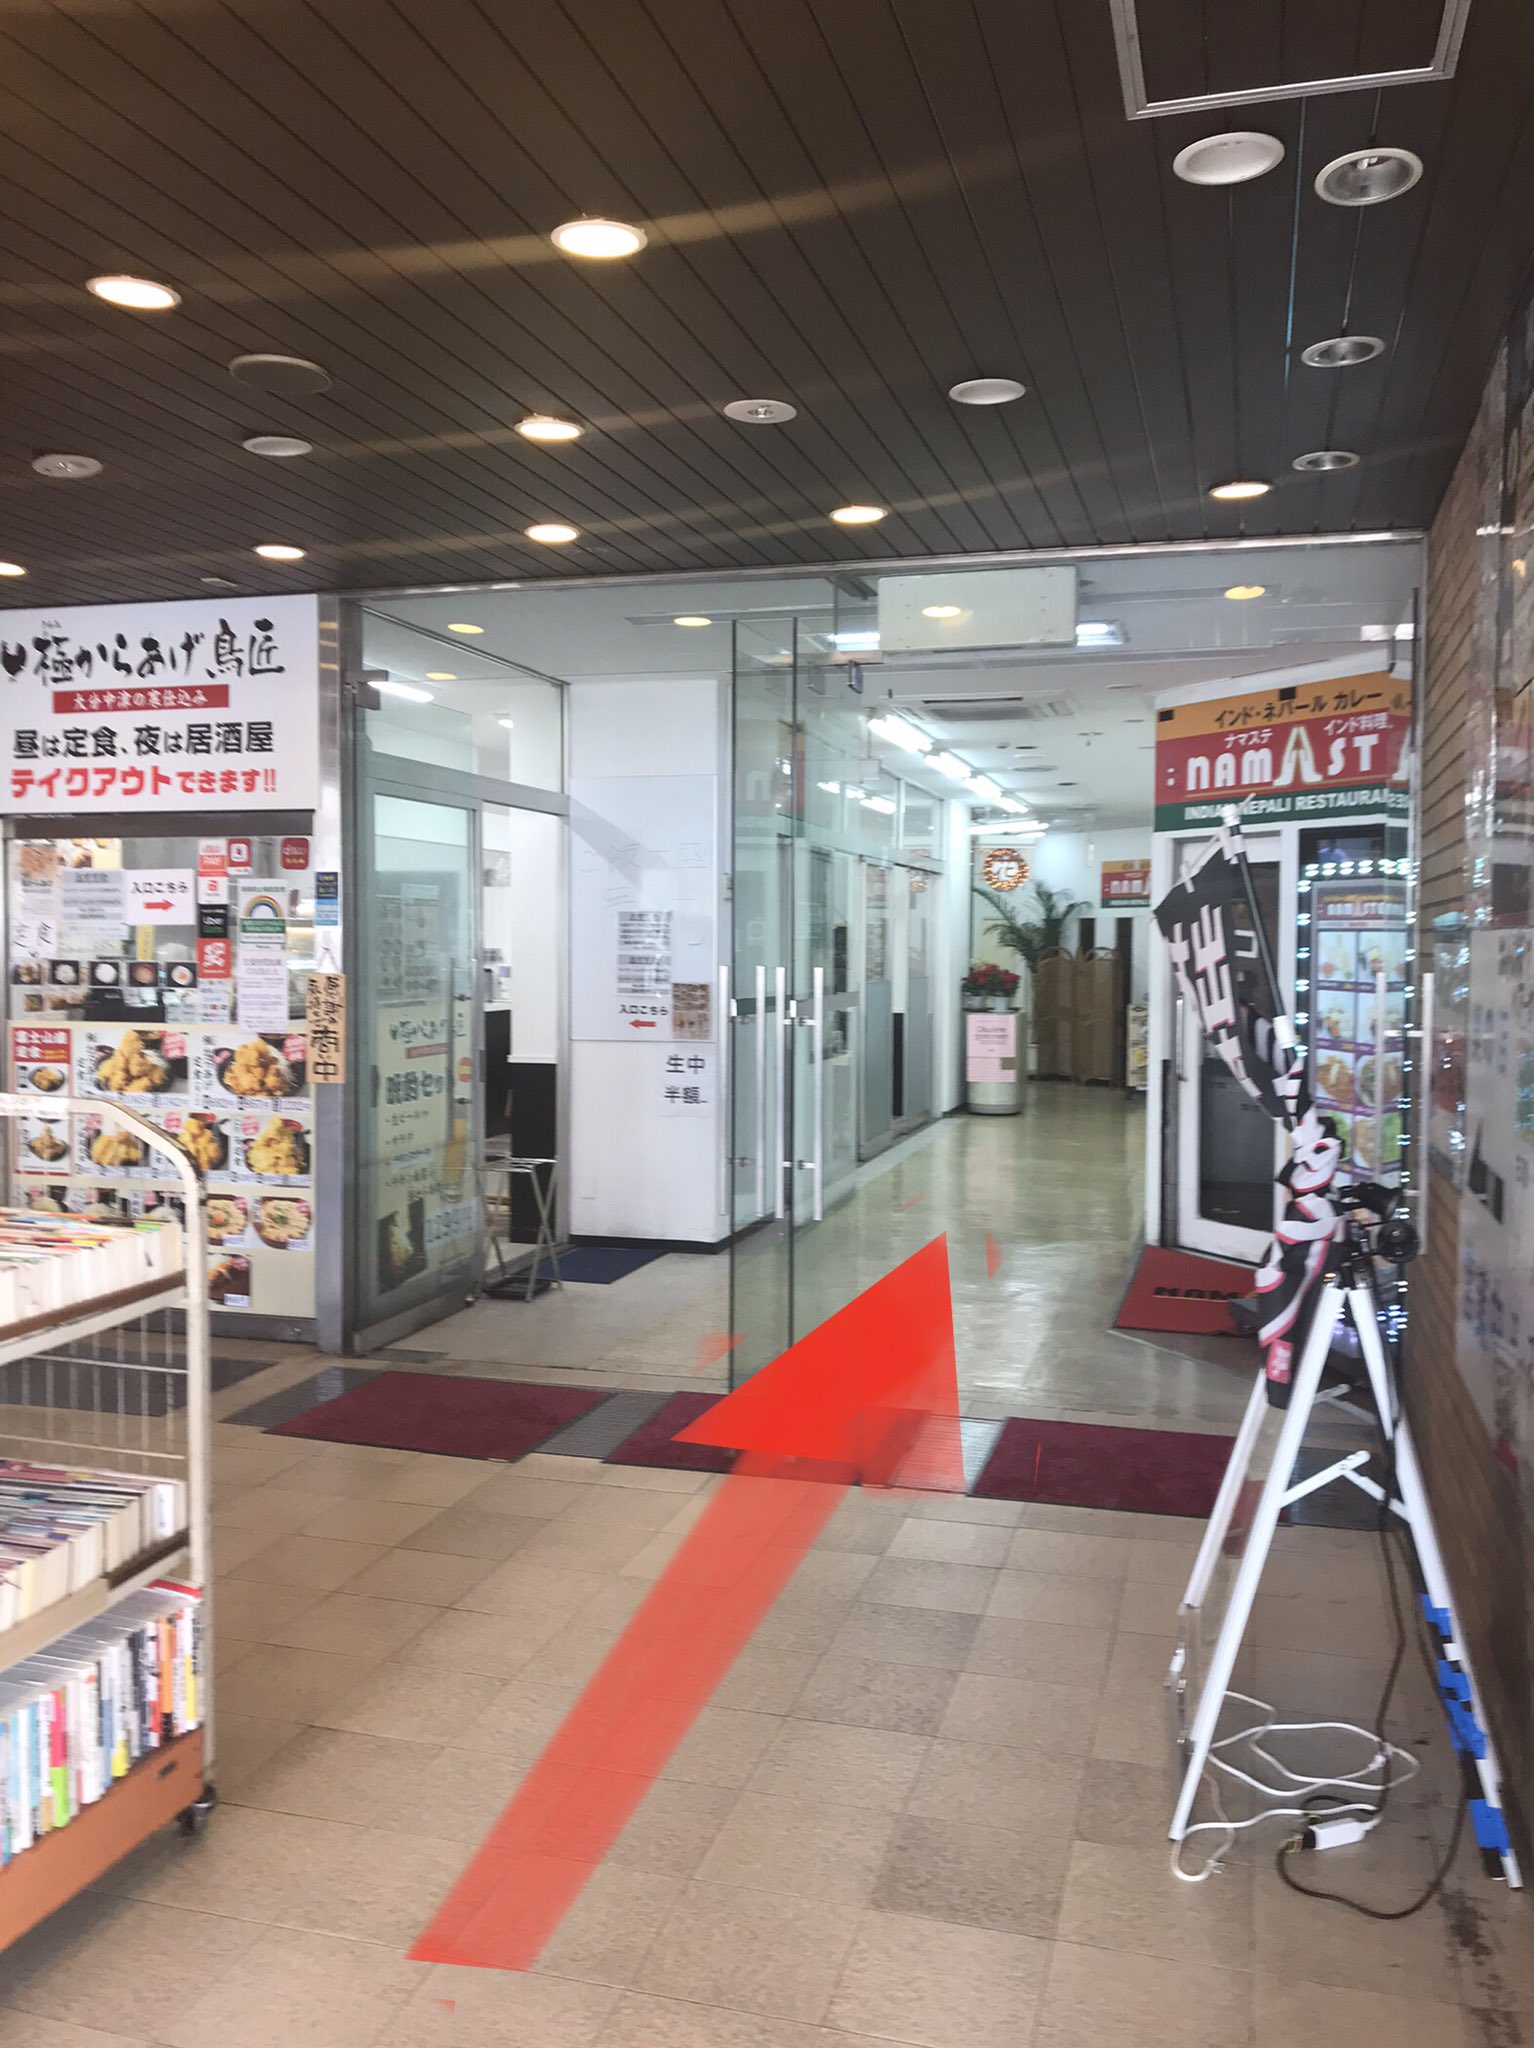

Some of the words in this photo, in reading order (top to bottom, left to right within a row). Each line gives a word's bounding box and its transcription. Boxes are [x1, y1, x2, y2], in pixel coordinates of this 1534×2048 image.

[1334, 691, 1383, 711] カレー
[1224, 728, 1273, 748] ナマステ
[130, 881, 190, 895] 入口こちら
[618, 1003, 670, 1016] 入口こちら
[665, 1054, 705, 1075] 生中
[664, 1085, 708, 1105] 半額
